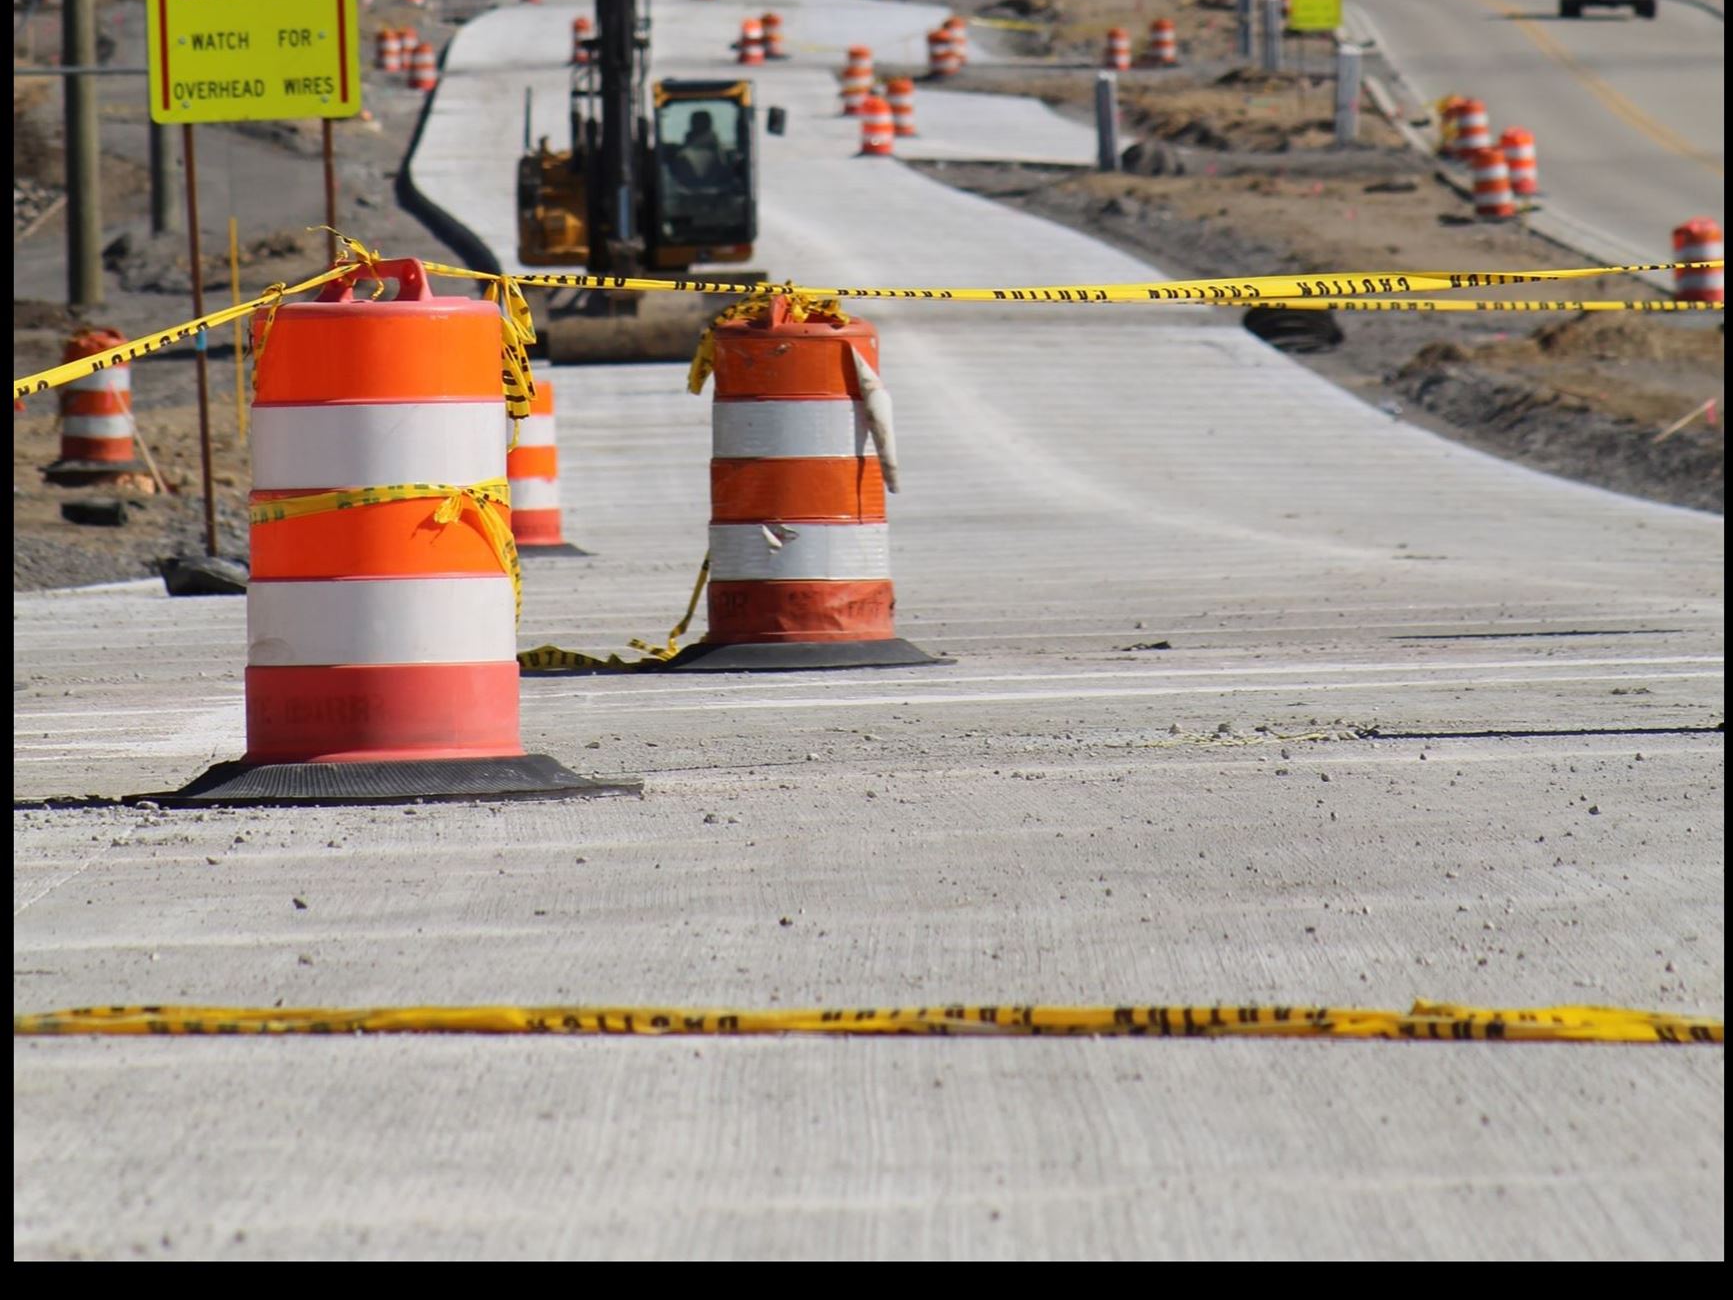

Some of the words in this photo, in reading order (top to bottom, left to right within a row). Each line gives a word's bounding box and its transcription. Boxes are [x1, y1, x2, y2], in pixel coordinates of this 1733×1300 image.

[191, 32, 249, 50] WATCH
[278, 29, 312, 47] FOR
[174, 79, 265, 100] OVERHEAD
[283, 77, 334, 96] WIRES
